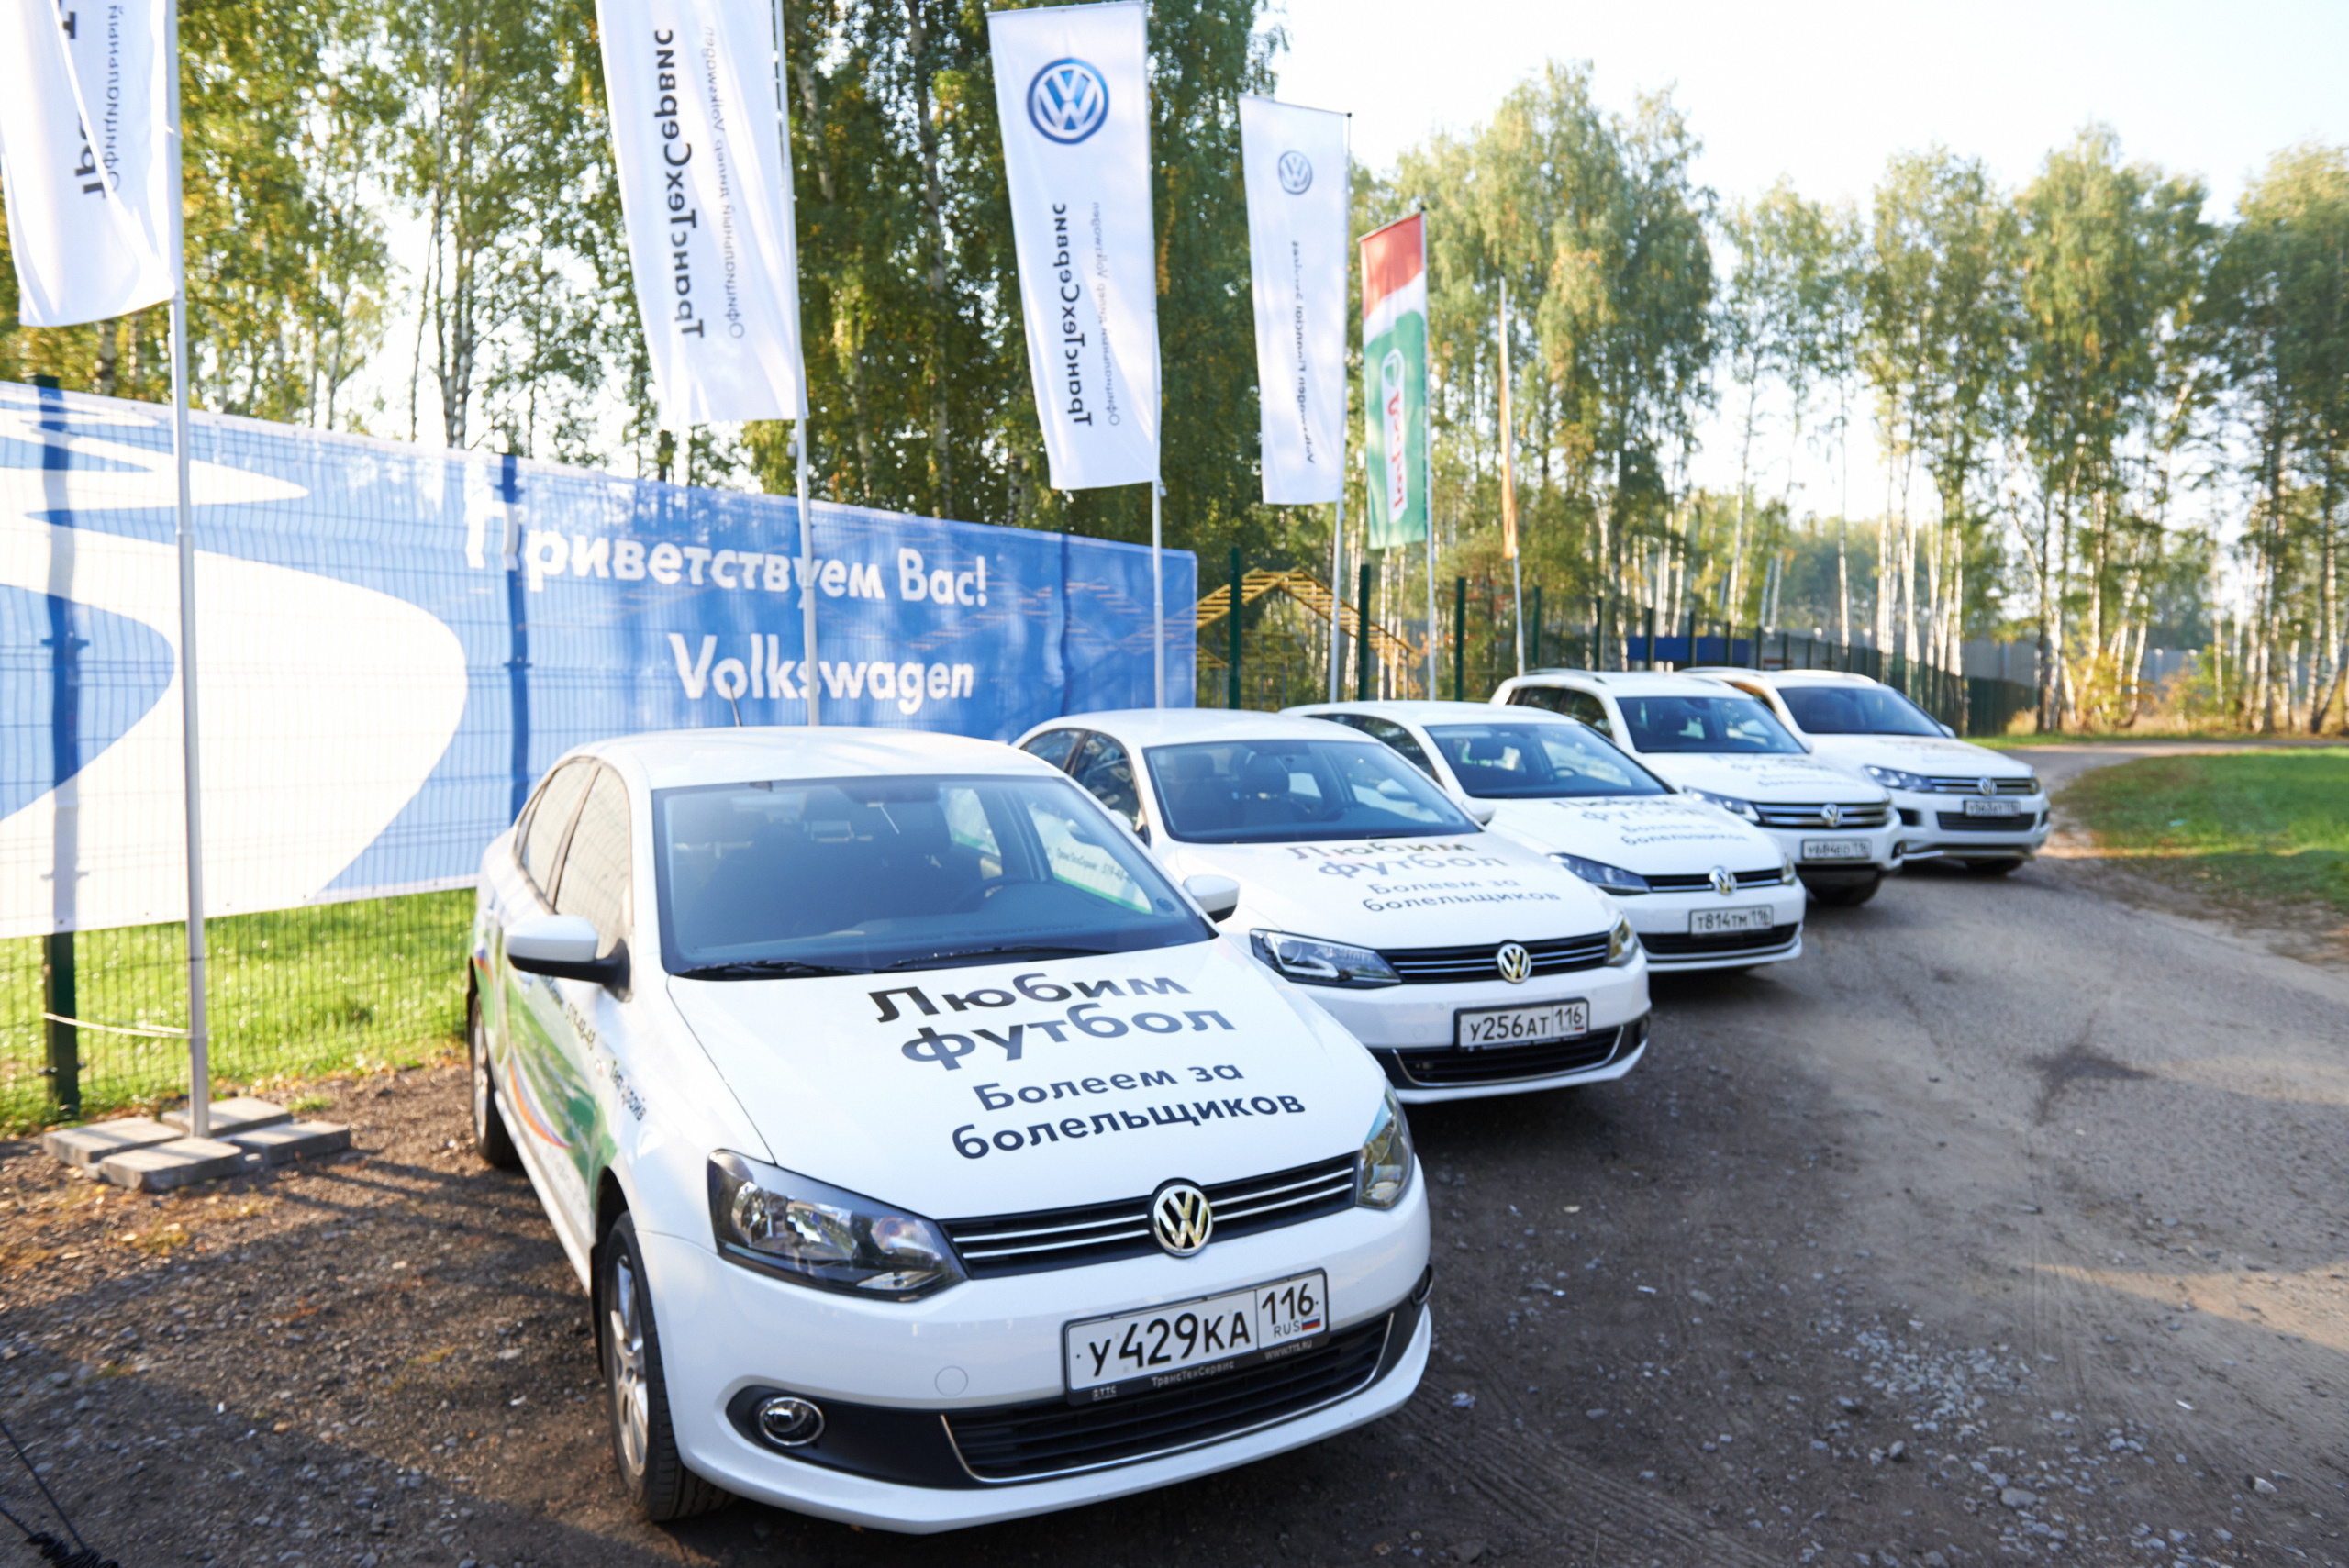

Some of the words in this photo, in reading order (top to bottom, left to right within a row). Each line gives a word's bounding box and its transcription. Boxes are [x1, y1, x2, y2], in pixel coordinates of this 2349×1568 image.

[464, 496, 886, 610] Приветствуем
[899, 549, 988, 607] Вас!
[668, 633, 974, 715] Volkswagen
[1286, 840, 1476, 859] Любим
[1318, 853, 1508, 878] футбол
[1362, 892, 1562, 912] болельщиков
[1367, 880, 1482, 895] Болеем
[867, 973, 1192, 1023] Любим
[1555, 1006, 1583, 1027] 116
[900, 1003, 1237, 1071] футбол
[972, 1069, 1178, 1111] Болеем
[1187, 1064, 1244, 1083] за
[951, 1095, 1306, 1159] болельщиков
[1089, 1312, 1251, 1377] У429КА
[1261, 1284, 1314, 1325] 116
[1273, 1319, 1301, 1339] RUS
[1152, 1361, 1235, 1387] ТрансТехСервис
